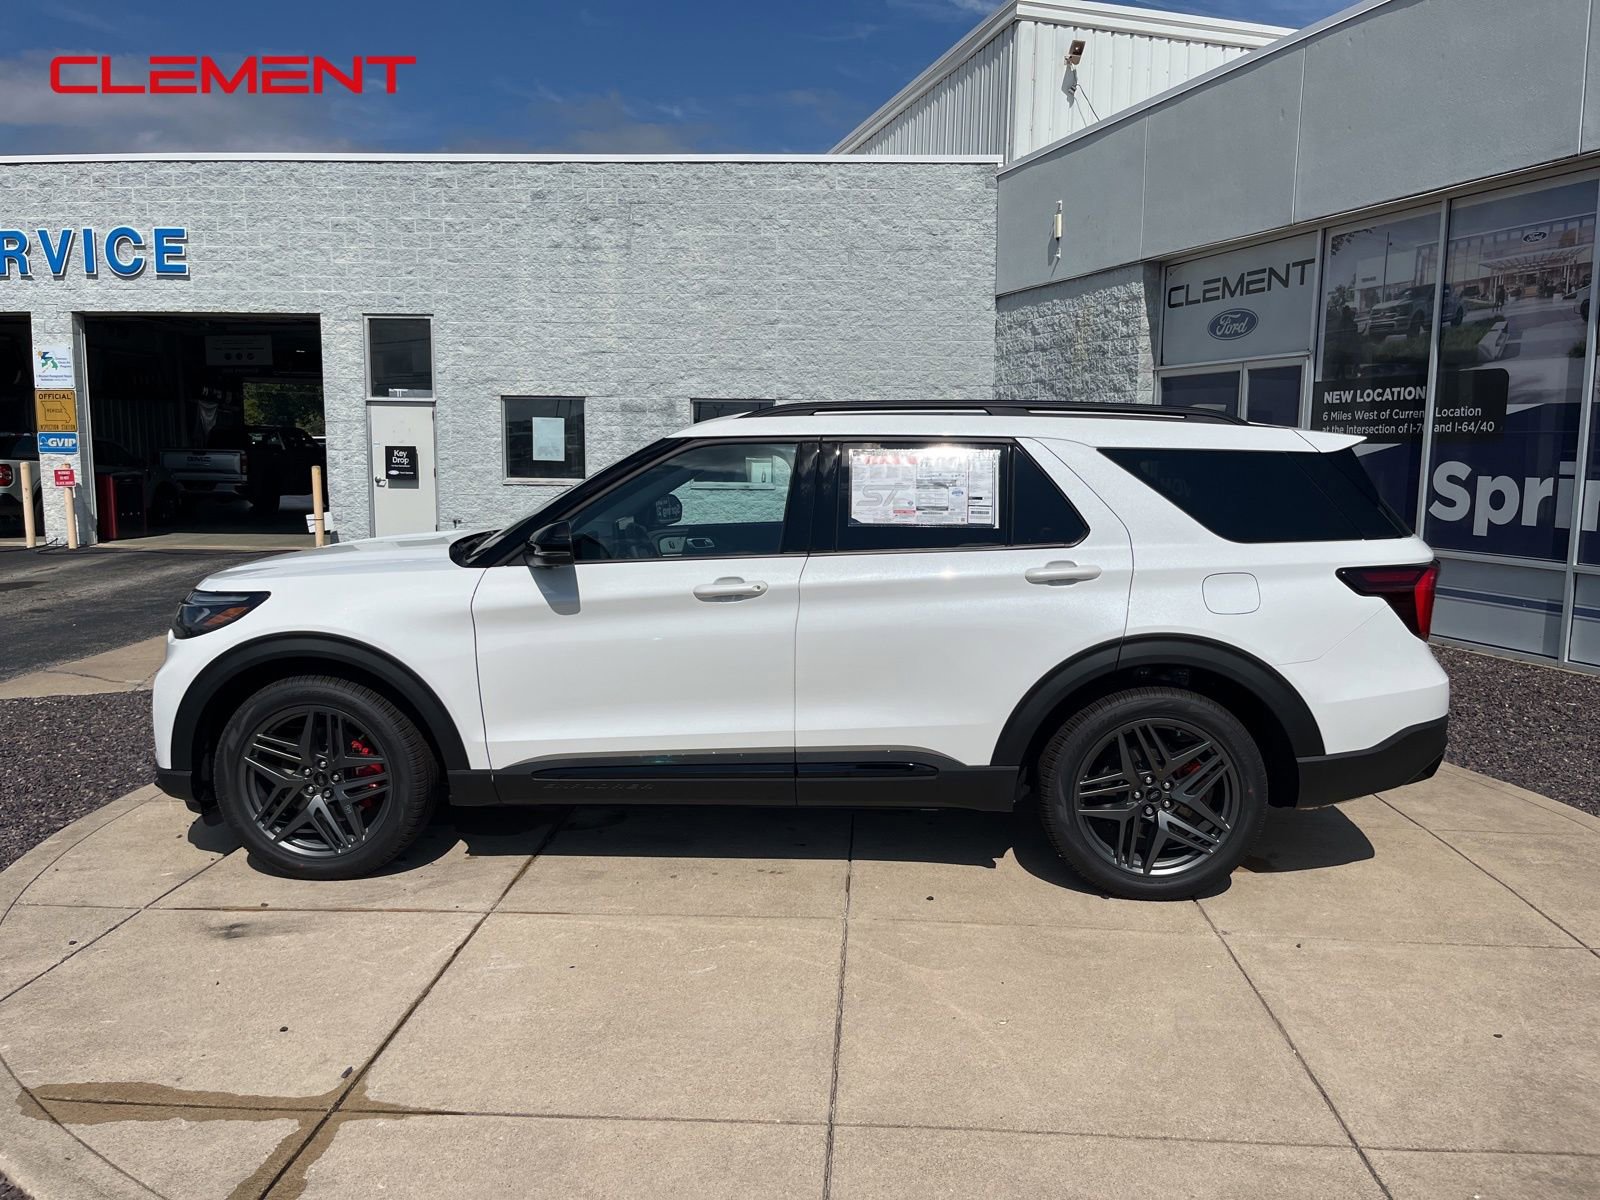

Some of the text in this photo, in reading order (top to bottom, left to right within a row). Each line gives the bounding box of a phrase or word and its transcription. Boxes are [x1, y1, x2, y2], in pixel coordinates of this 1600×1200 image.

[1167, 257, 1316, 309] CLEMENT
[1215, 313, 1249, 336] Ford
[1324, 386, 1427, 404] NEW LOCATION
[1322, 405, 1482, 421] 6 Miles West of Curren Location
[1332, 425, 1344, 434] the
[1346, 424, 1396, 434] Intersection
[1398, 423, 1408, 433] of
[1434, 422, 1452, 432] and
[1454, 421, 1495, 434] I-64/40
[48, 438, 76, 446] GVIP
[393, 449, 407, 458] Key
[392, 457, 409, 465] Drop
